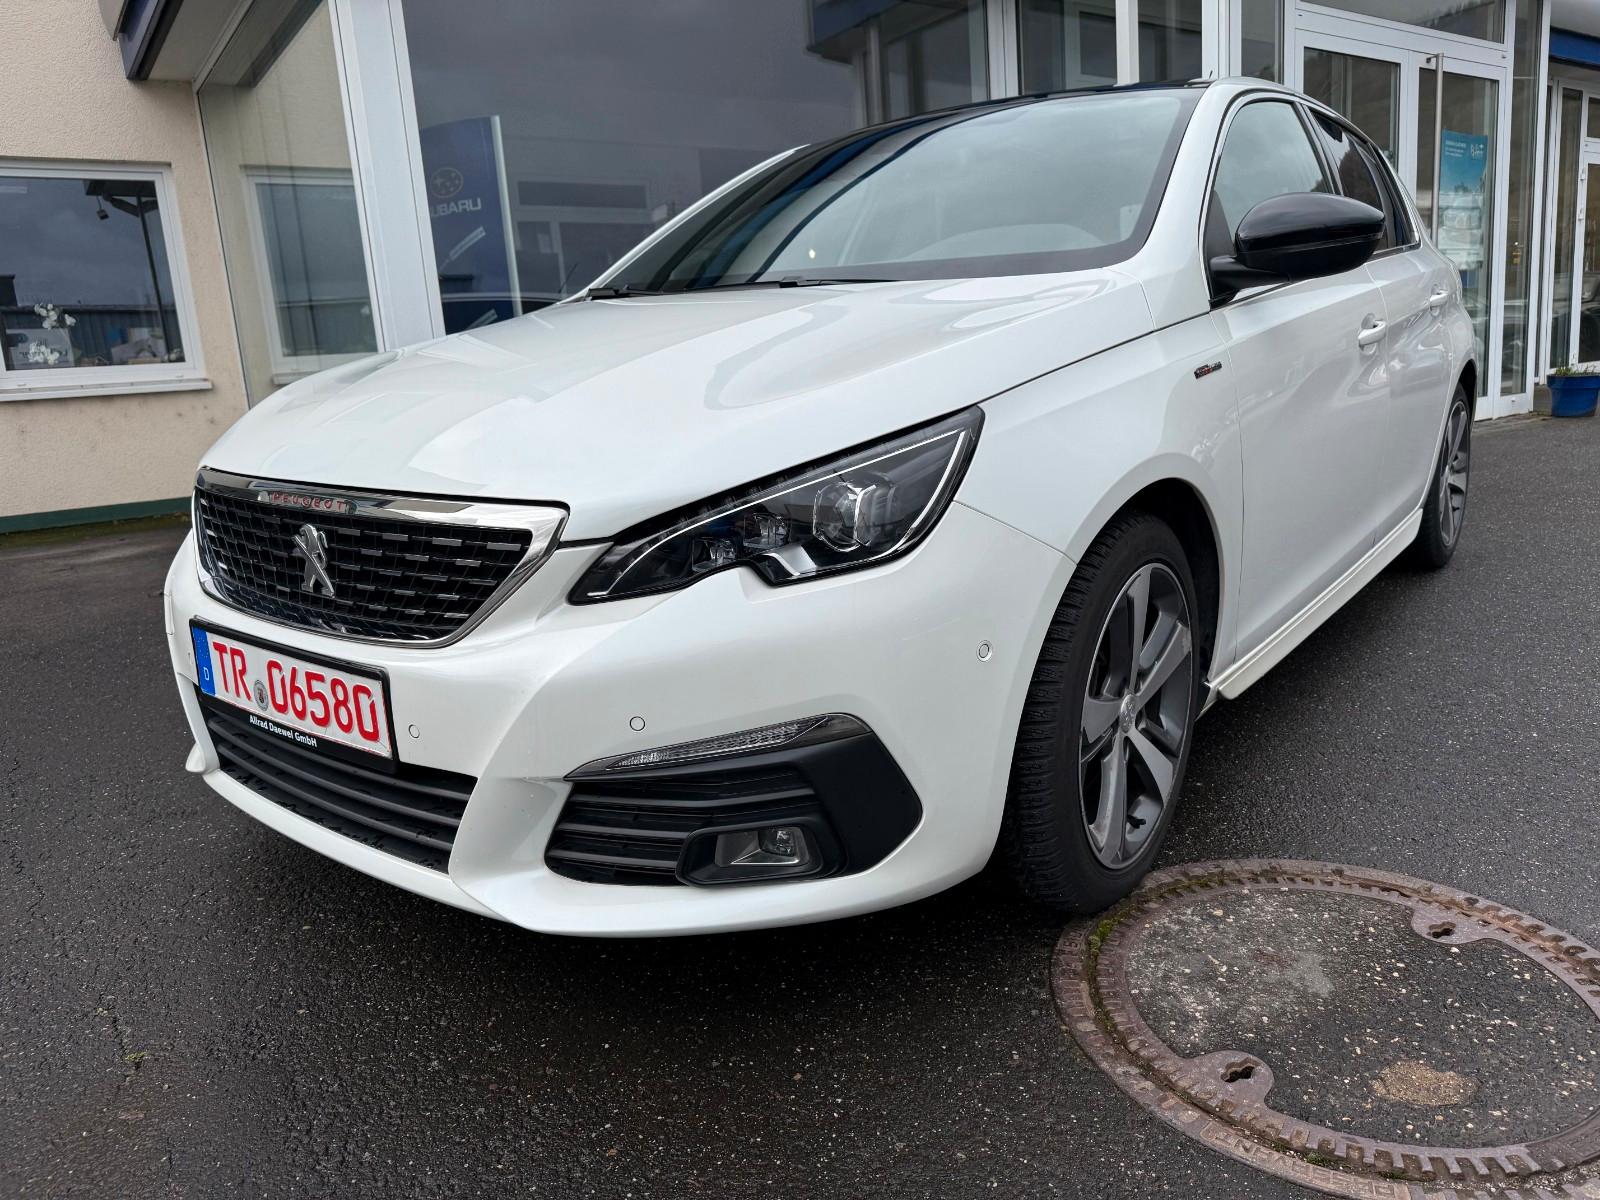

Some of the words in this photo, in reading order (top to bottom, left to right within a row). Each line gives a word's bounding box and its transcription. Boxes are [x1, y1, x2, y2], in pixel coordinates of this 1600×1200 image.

[430, 197, 482, 217] UBARU
[271, 490, 345, 511] PEUGEOT
[212, 641, 252, 701] TR
[266, 659, 380, 742] 06580
[249, 714, 268, 730] Allrad
[268, 722, 294, 739] Daewel
[294, 732, 317, 747] GmbH
